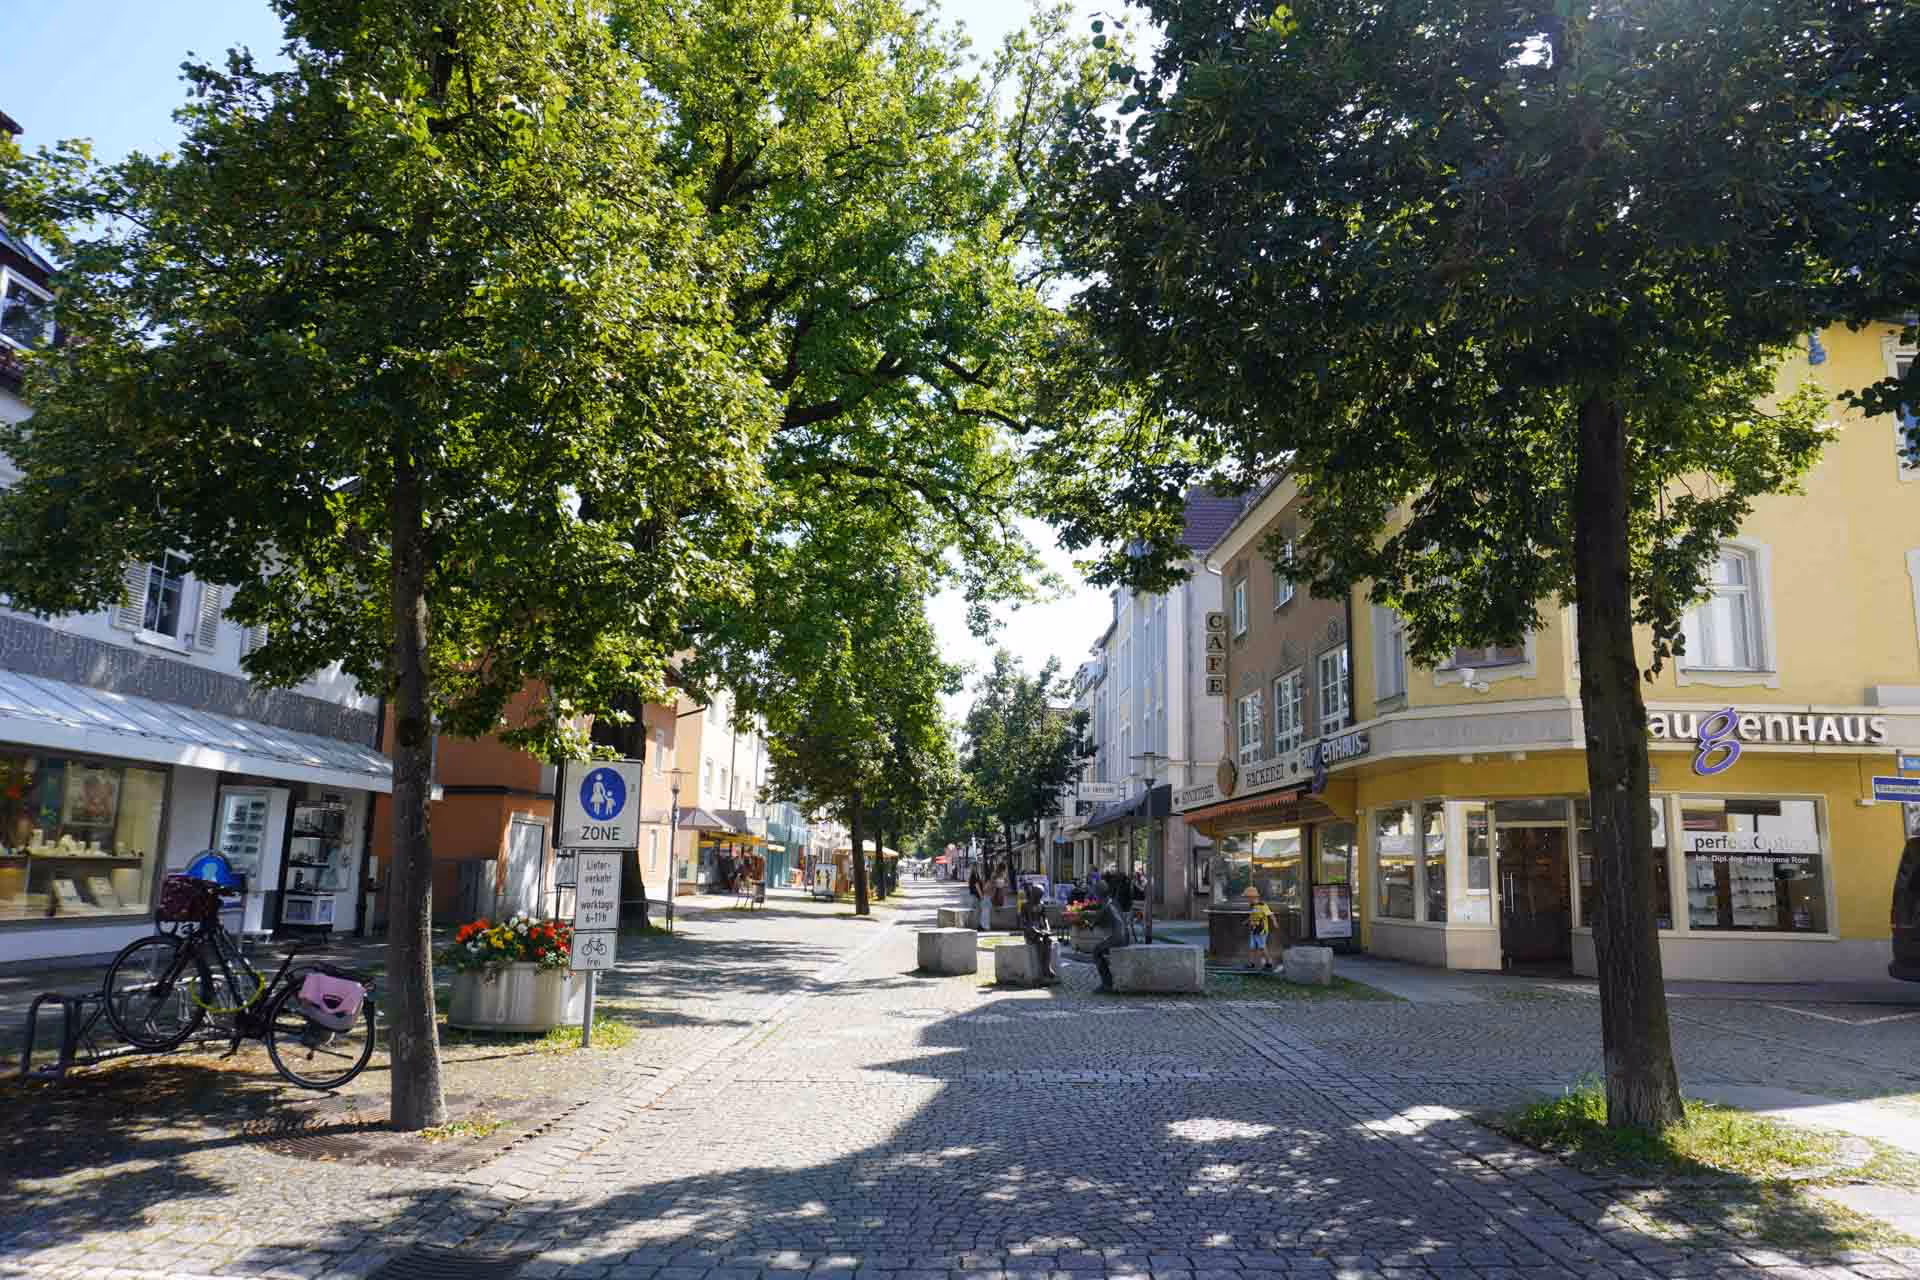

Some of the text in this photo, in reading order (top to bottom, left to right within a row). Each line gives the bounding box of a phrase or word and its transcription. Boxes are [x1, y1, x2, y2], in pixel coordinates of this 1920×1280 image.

[1648, 707, 1887, 776] augenHAUS
[582, 826, 621, 840] ZONE
[591, 887, 605, 897] frei
[586, 957, 601, 967] frei
